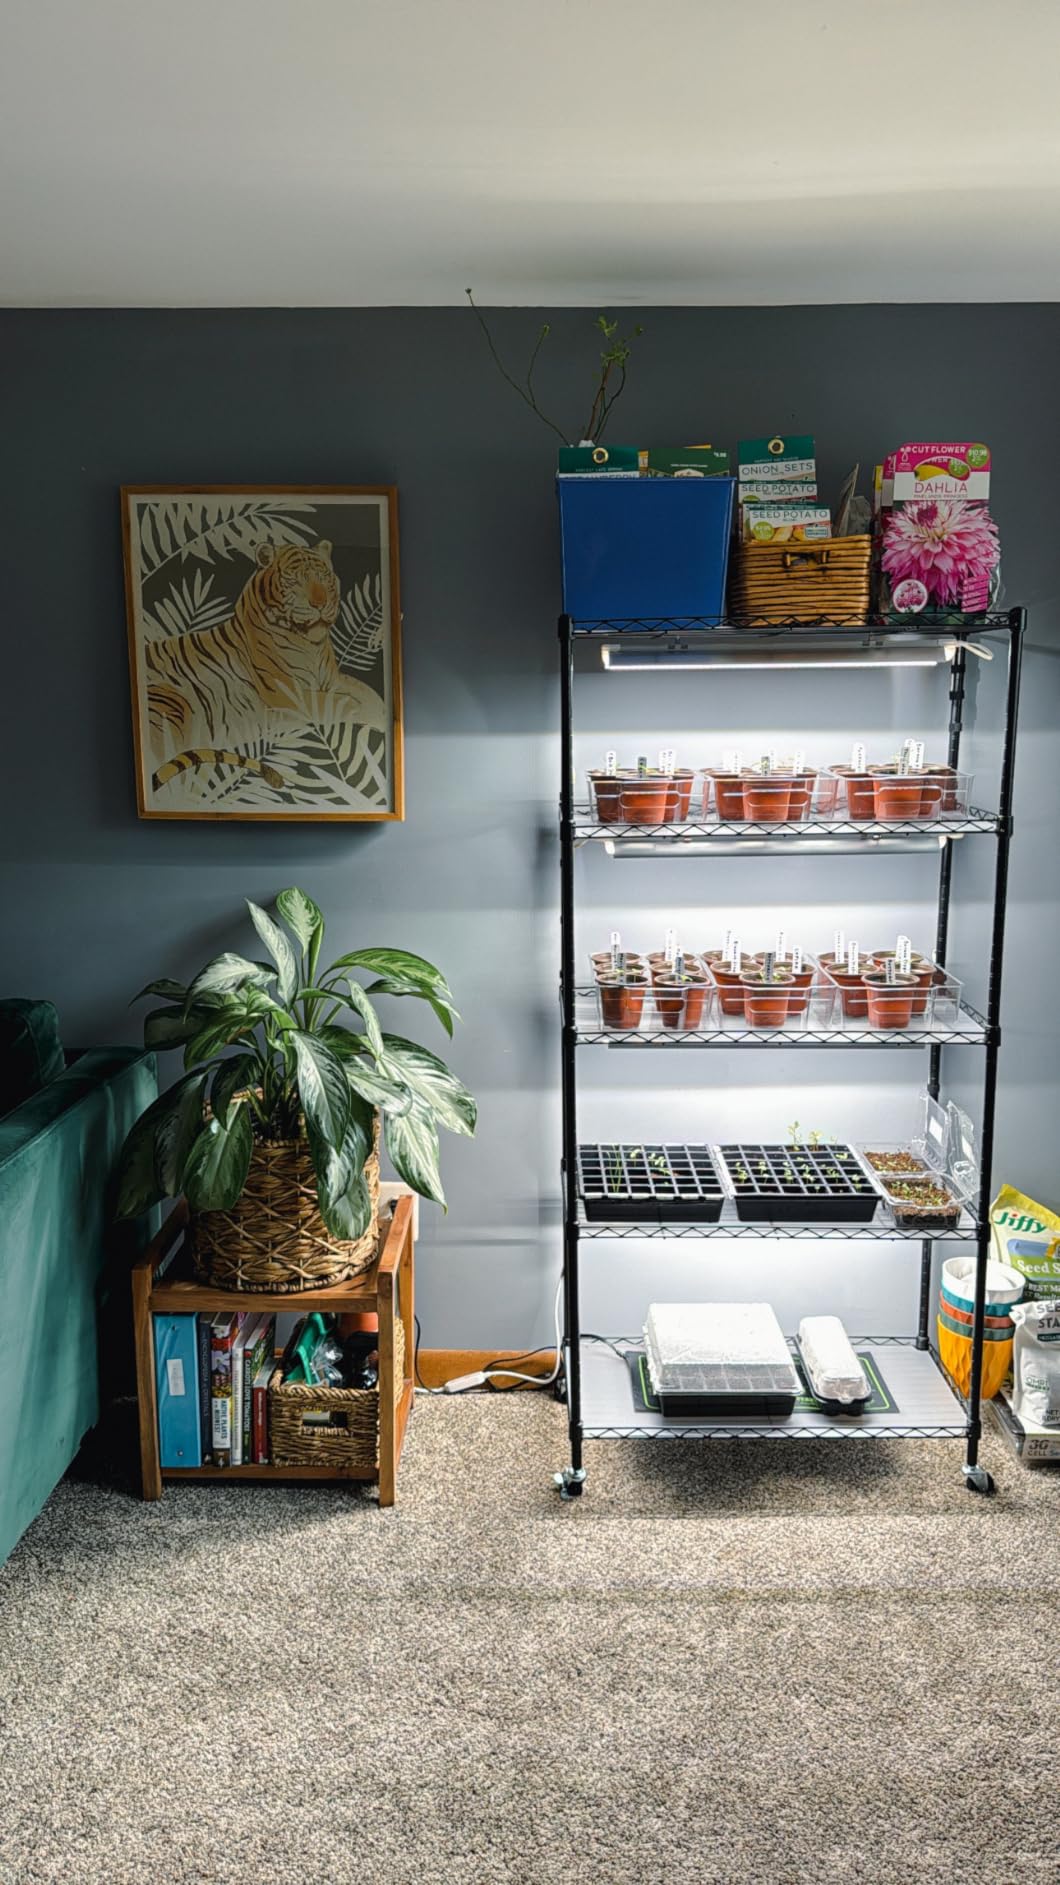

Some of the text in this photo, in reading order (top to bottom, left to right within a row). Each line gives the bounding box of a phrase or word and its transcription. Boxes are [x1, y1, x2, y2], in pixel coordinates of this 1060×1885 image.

[911, 446, 966, 454] CUT FLOWER
[742, 462, 813, 476] ONION SETS
[772, 485, 815, 493] POTATO
[914, 482, 968, 493] DAHLIA
[752, 510, 828, 519] SEED POTATO
[994, 1212, 1047, 1233] Jiffy
[1017, 1259, 1049, 1273] Seed
